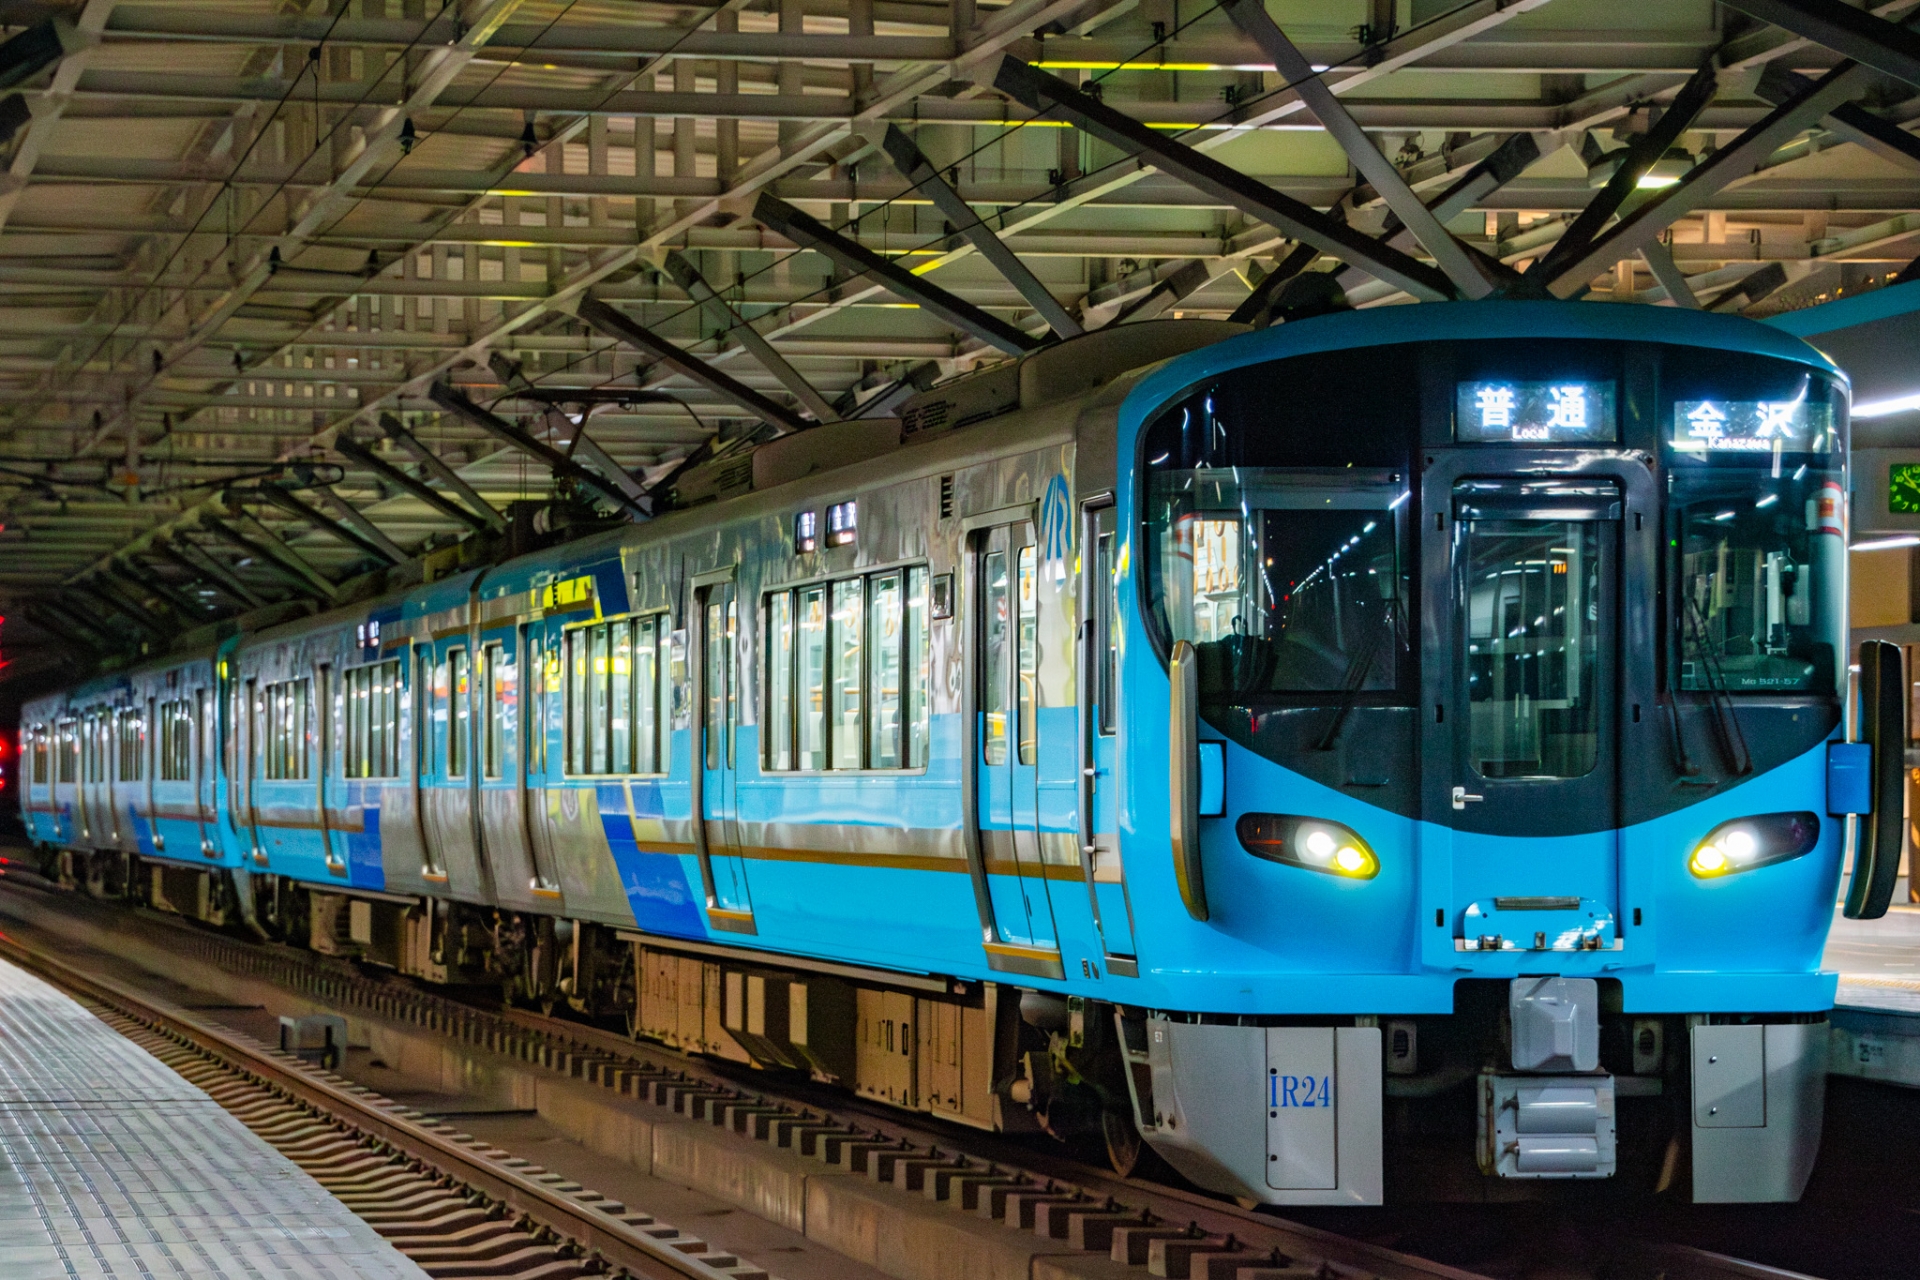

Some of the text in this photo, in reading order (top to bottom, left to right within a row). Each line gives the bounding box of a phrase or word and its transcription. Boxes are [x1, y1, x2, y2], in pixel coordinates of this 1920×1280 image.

[1475, 386, 1587, 428] 普通
[1687, 400, 1794, 438] 金沢
[1512, 425, 1549, 439] Local
[1707, 436, 1771, 449] Kanazawa
[1270, 1075, 1331, 1107] IR24
